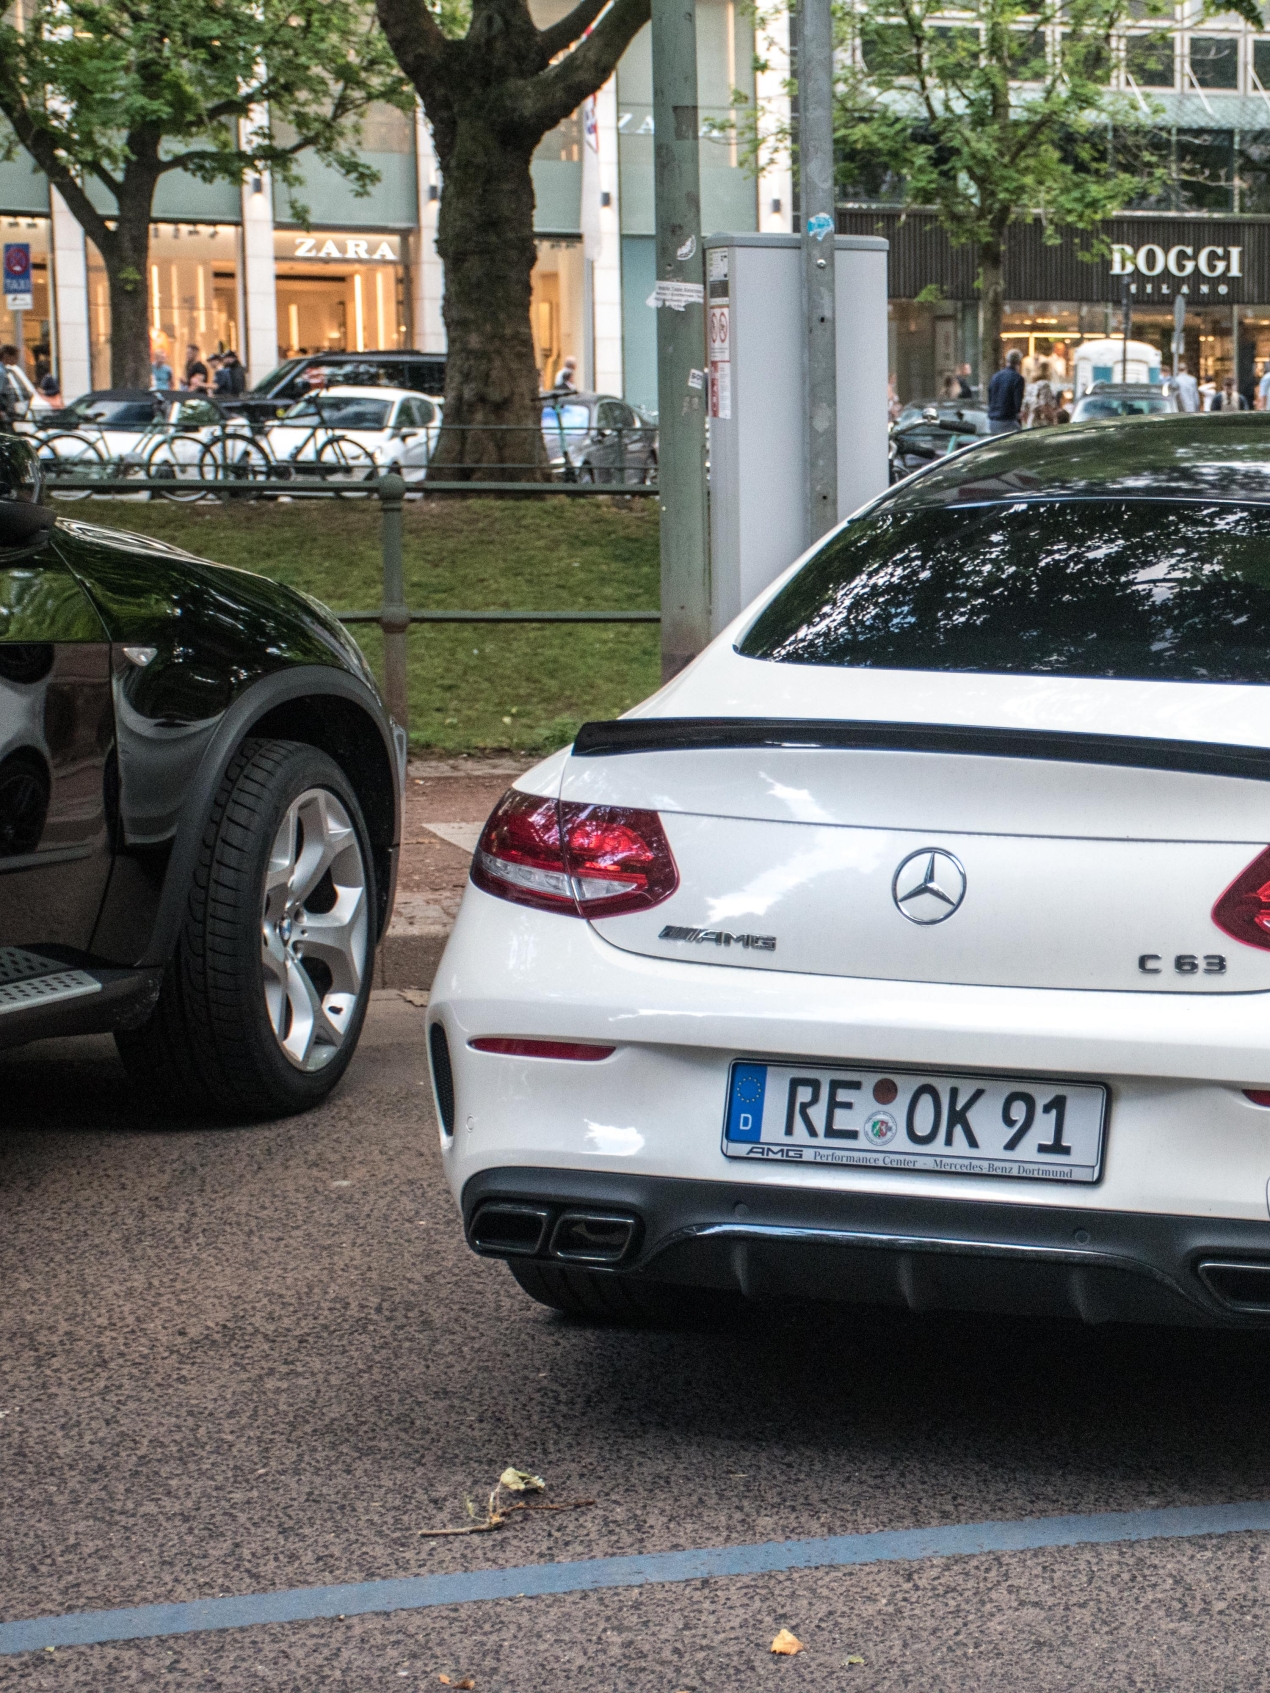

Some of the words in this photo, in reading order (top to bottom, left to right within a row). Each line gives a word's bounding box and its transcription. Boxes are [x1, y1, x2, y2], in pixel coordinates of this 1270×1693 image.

[294, 238, 398, 260] ZARA
[1109, 244, 1243, 277] BOGGI
[693, 928, 777, 951] AMG
[1138, 954, 1162, 974] C
[1174, 954, 1227, 974] 63
[739, 1113, 753, 1131] D
[783, 1076, 863, 1140] RE
[904, 1083, 986, 1149] OK
[1001, 1091, 1072, 1156] 91
[745, 1146, 803, 1160] AMG
[812, 1150, 880, 1165] Performance
[882, 1155, 918, 1168] Center
[932, 1158, 1014, 1175] Mercedes-Benz
[1017, 1164, 1073, 1179] Dortmund
